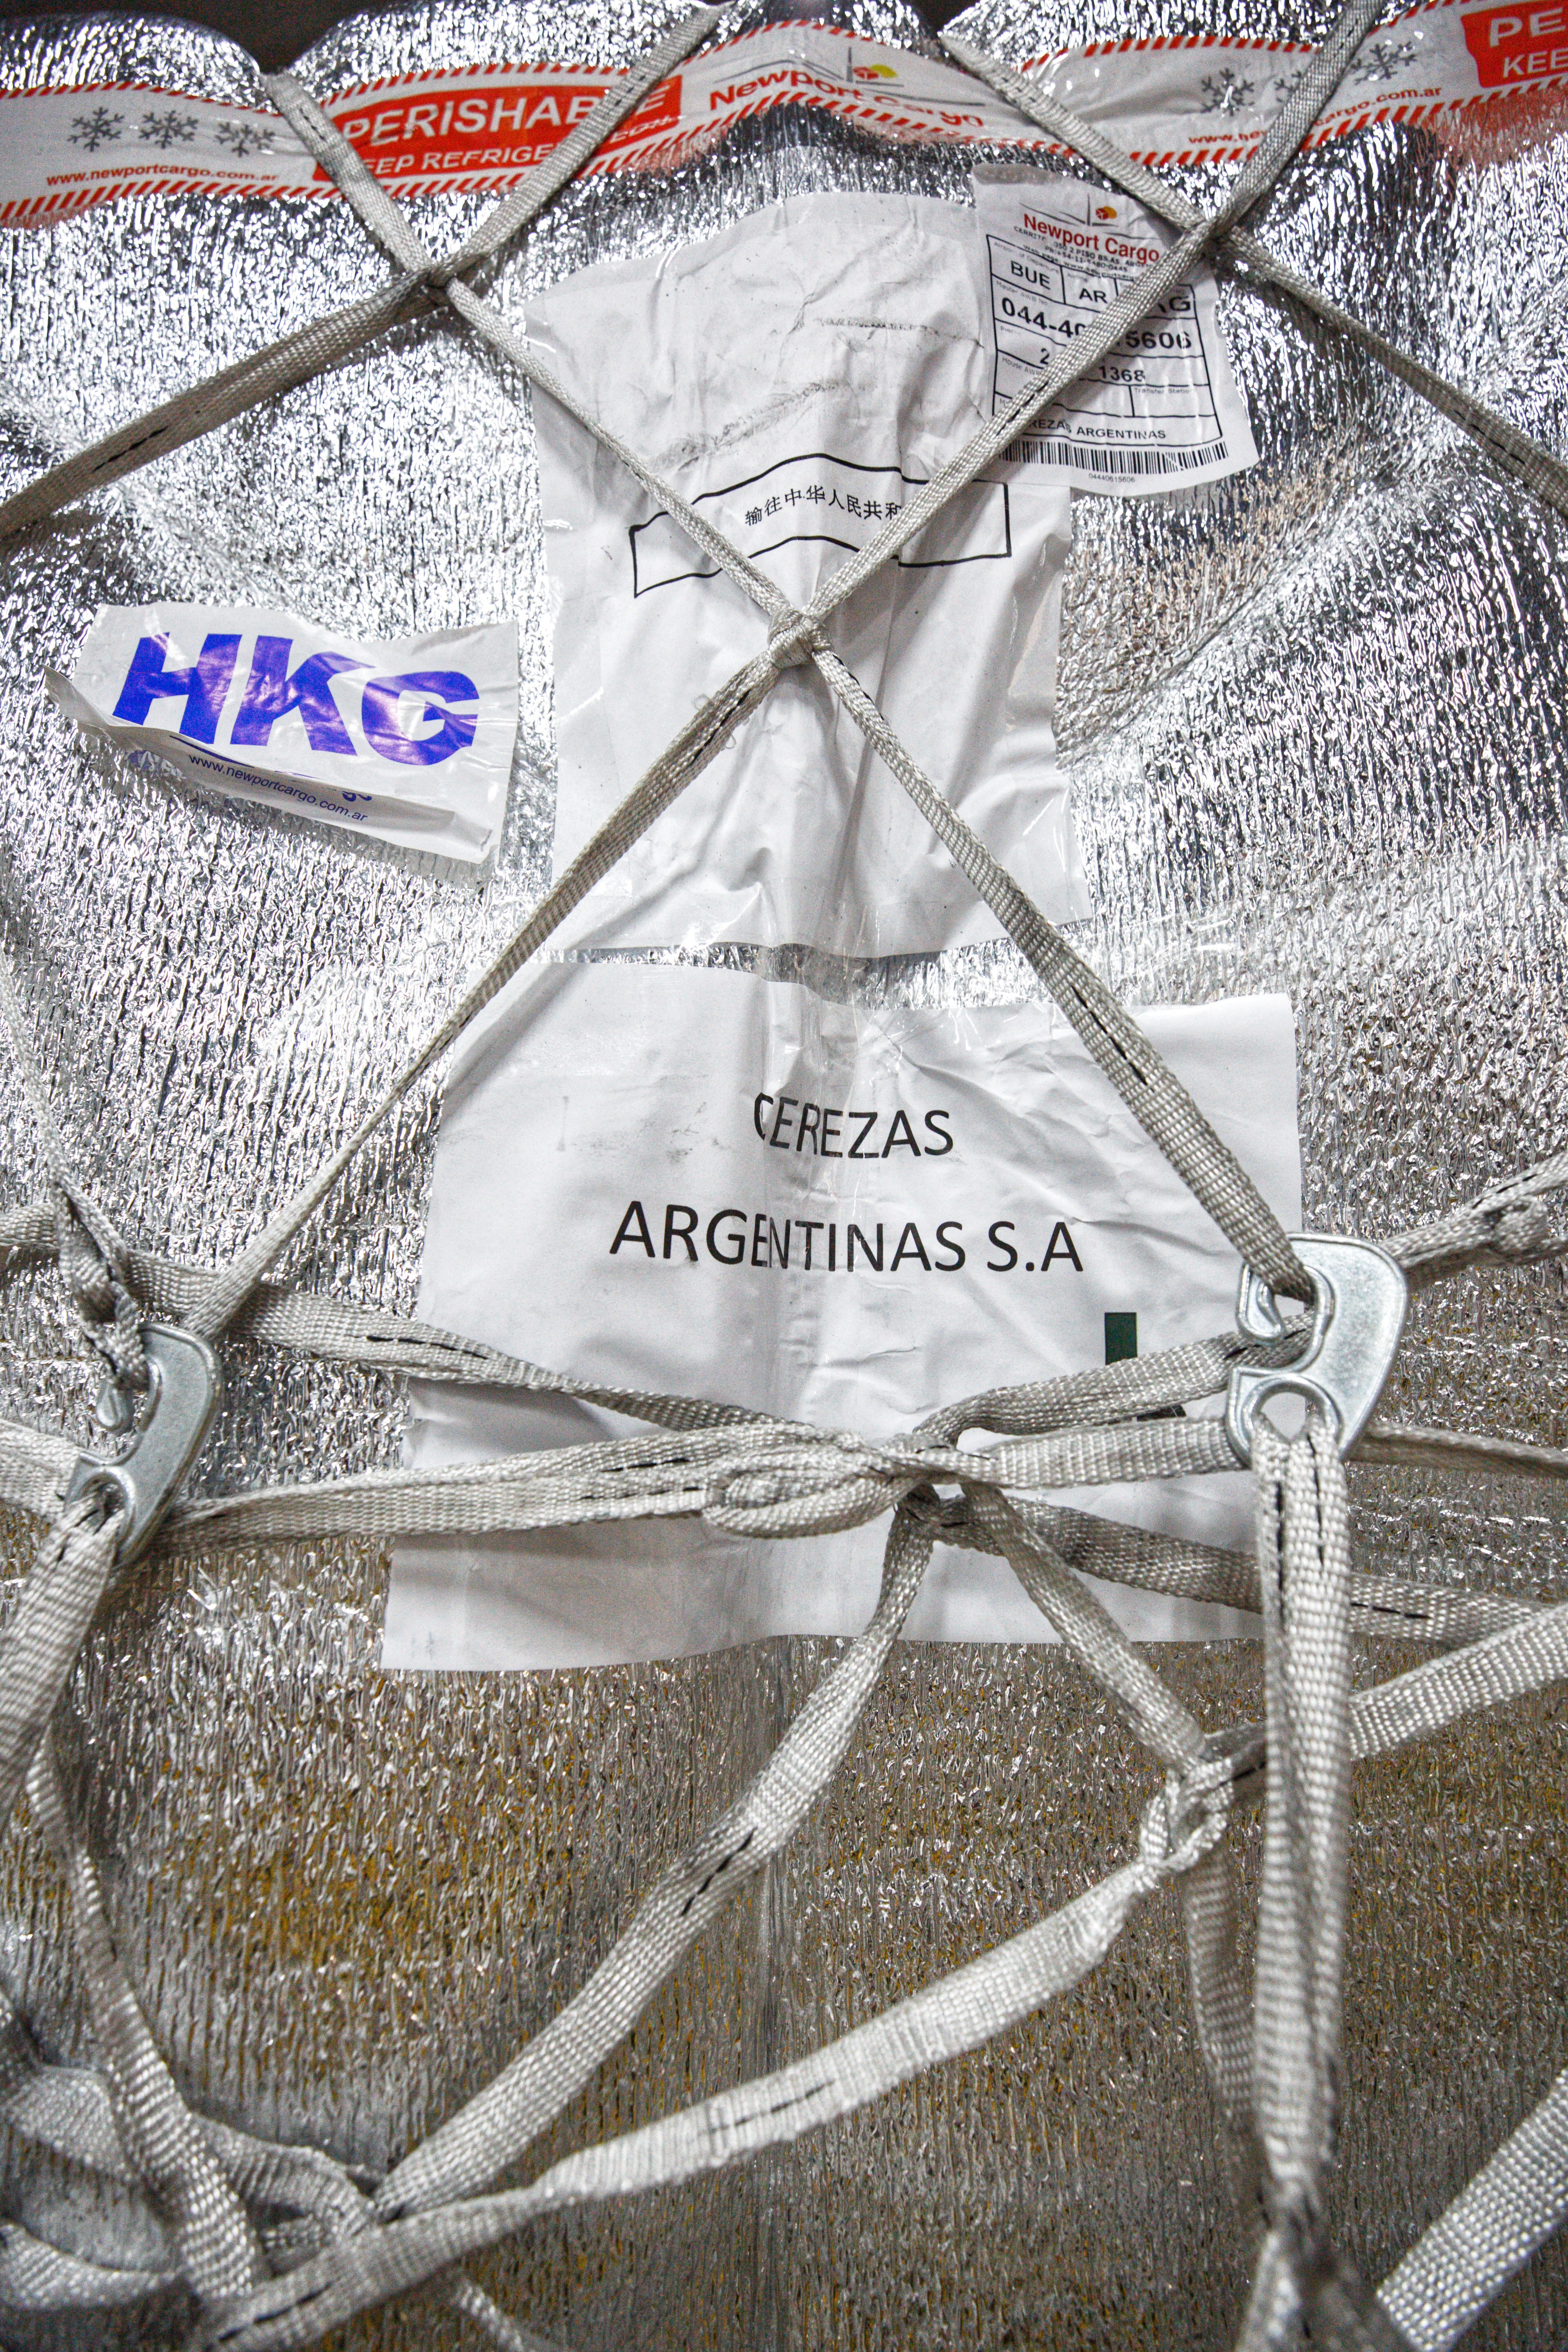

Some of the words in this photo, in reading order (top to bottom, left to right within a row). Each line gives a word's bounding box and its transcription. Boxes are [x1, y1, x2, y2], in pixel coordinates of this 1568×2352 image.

[342, 85, 670, 146] PERISHABE
[710, 69, 862, 110] Newport
[873, 95, 983, 127] Cargo
[46, 164, 279, 186] www.newportcargo.com.ar
[1024, 213, 1099, 251] Newport
[1105, 236, 1159, 265] Cargo
[1011, 260, 1051, 290] BUE
[1079, 287, 1108, 304] AR
[1076, 426, 1167, 439] ARGENTINAS
[111, 632, 479, 766] HKG
[189, 755, 368, 821] www.newportcargo.com.ar
[753, 1091, 953, 1158] CEREZAS
[609, 1200, 966, 1272] ARGENTINAS
[987, 1220, 1084, 1272] S.A
